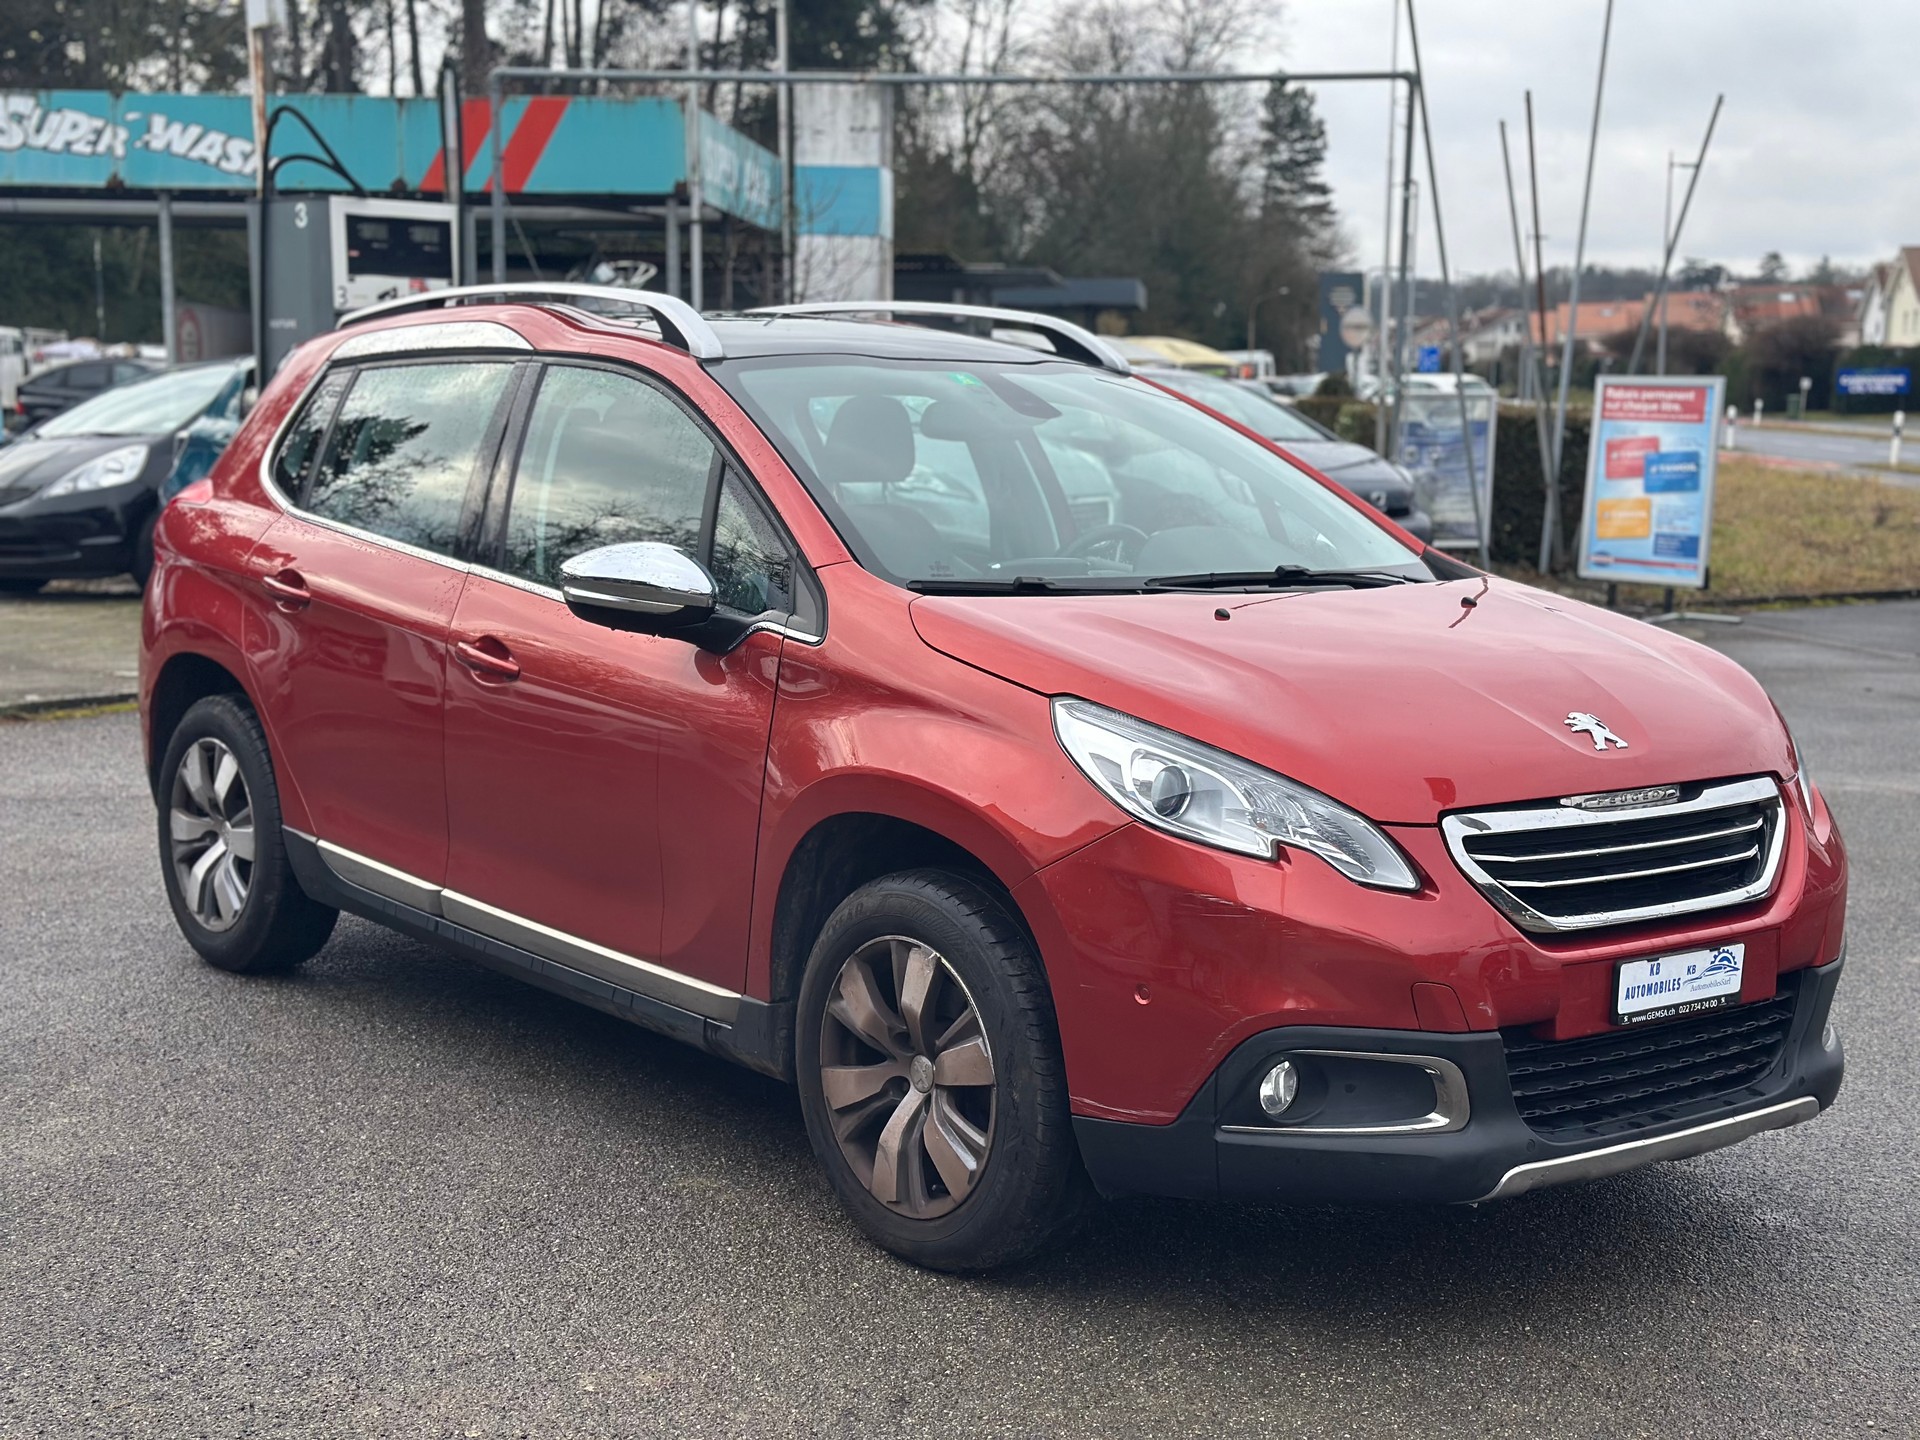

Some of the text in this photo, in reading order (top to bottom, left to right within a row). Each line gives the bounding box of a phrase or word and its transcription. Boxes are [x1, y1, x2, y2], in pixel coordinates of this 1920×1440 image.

[0, 94, 130, 158] SUPER
[294, 202, 308, 229] 3
[337, 286, 348, 307] 3
[1640, 389, 1696, 402] permanent
[1622, 400, 1659, 412] chaque
[1597, 788, 1675, 805] PEUGEO
[1649, 962, 1661, 976] KB
[1686, 964, 1697, 976] KB
[1624, 977, 1682, 1001] AUTOMOBILES
[1632, 999, 1718, 1023] www.GEMSA.ch 022 734 24 00
